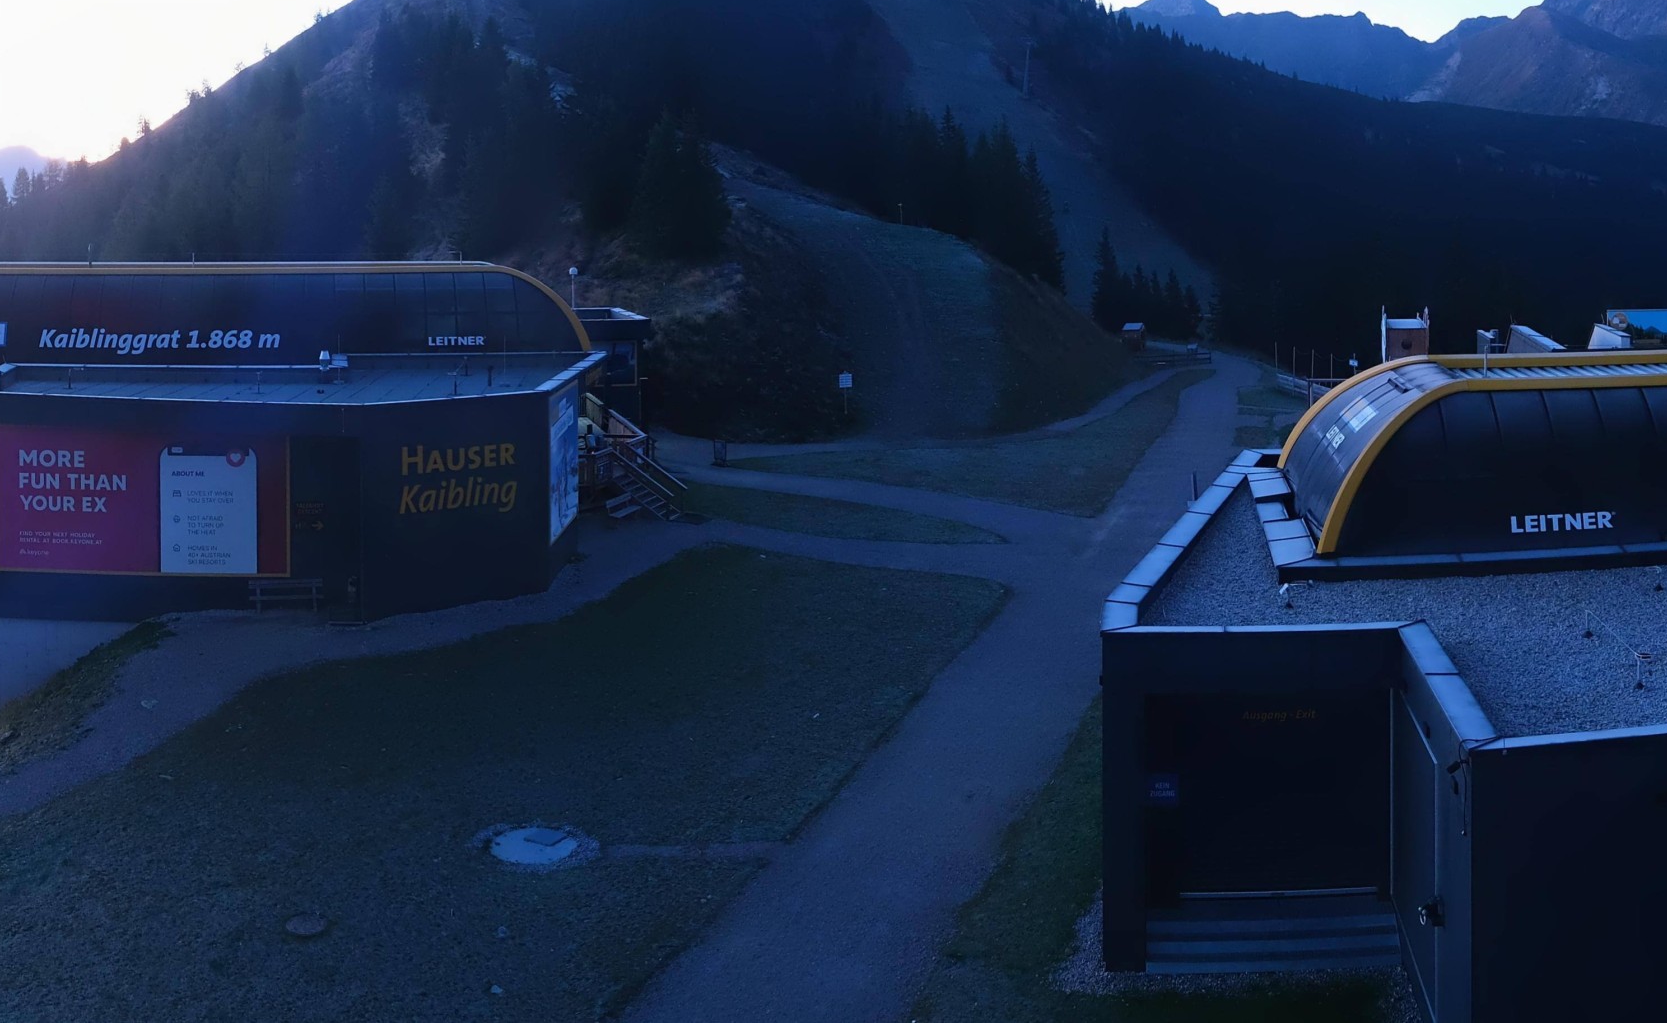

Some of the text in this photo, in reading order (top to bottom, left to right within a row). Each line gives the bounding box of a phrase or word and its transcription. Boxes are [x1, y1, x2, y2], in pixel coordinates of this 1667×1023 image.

[38, 328, 280, 355] Kaiblinggrat 1.868 m
[428, 336, 485, 347] LEITNER
[18, 449, 86, 468] MORE
[18, 473, 127, 491] FUN THAN
[19, 494, 107, 513] YOUR EX
[399, 476, 518, 515] Kaibling
[1510, 511, 1614, 533] LEITNER
[1242, 711, 1288, 722] Ausgang
[1295, 708, 1317, 719] Exit
